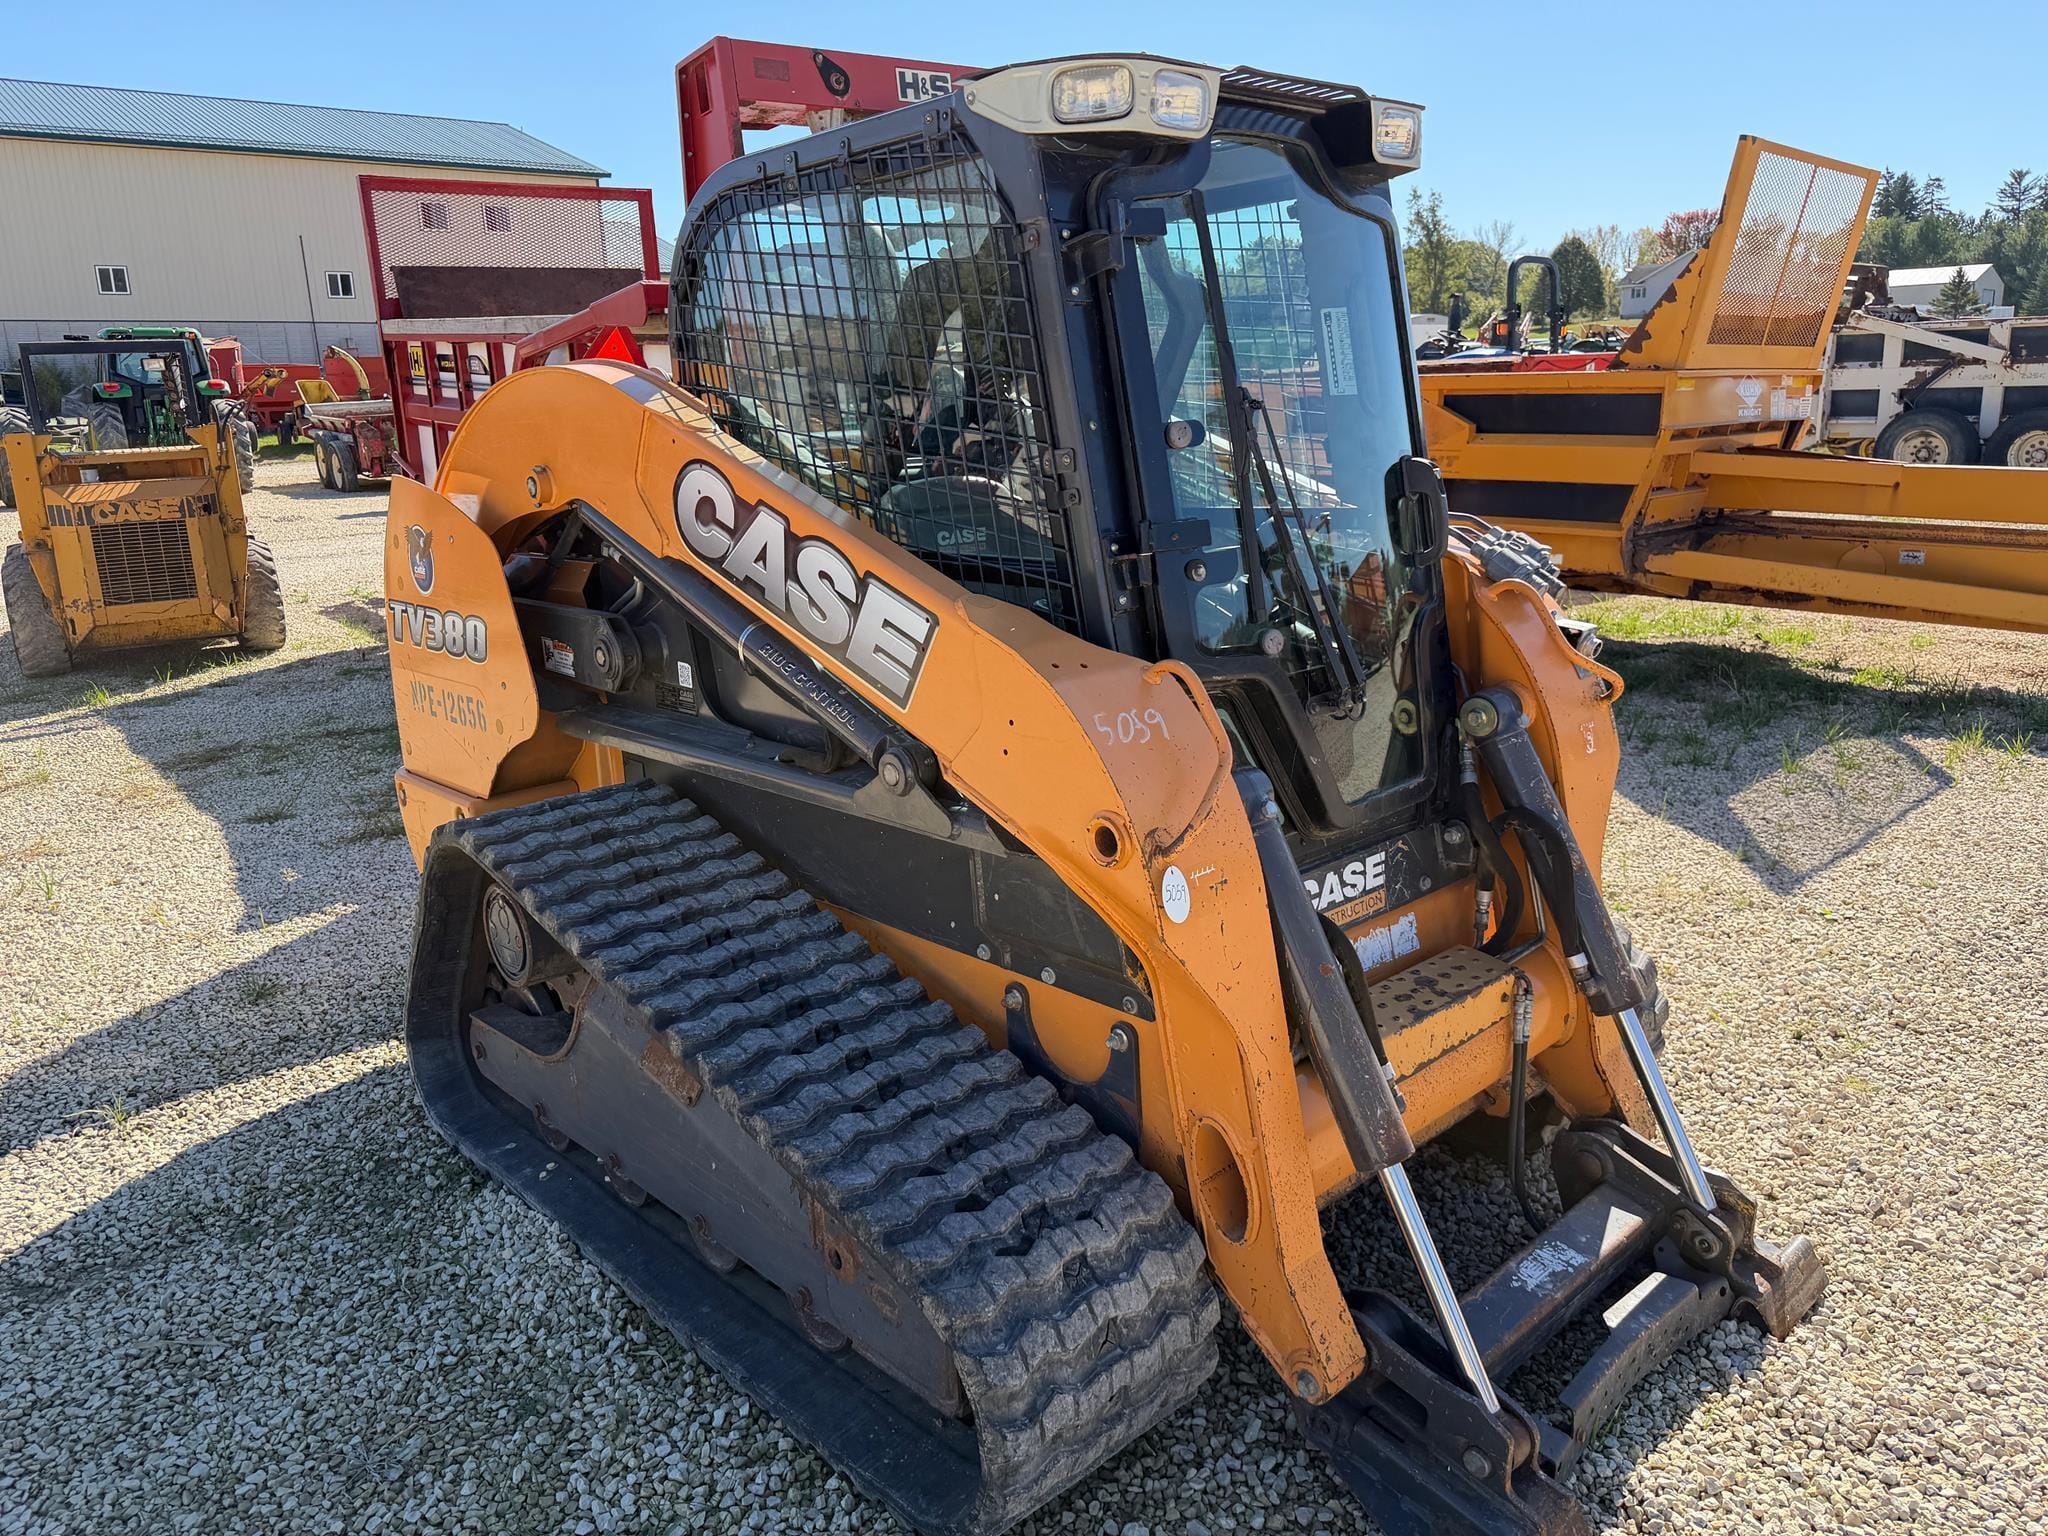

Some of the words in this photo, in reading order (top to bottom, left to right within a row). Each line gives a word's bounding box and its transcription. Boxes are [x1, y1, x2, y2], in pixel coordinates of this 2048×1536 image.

[898, 70, 950, 100] H&S
[92, 498, 183, 524] CASE
[936, 526, 986, 546] CASE
[675, 466, 933, 700] CASE
[390, 601, 487, 662] TV380
[410, 680, 488, 733] NPE-12656
[758, 642, 796, 676] RIDE
[792, 671, 858, 732] CONTROL
[1093, 707, 1169, 746] 5059
[1164, 883, 1187, 903] 5059
